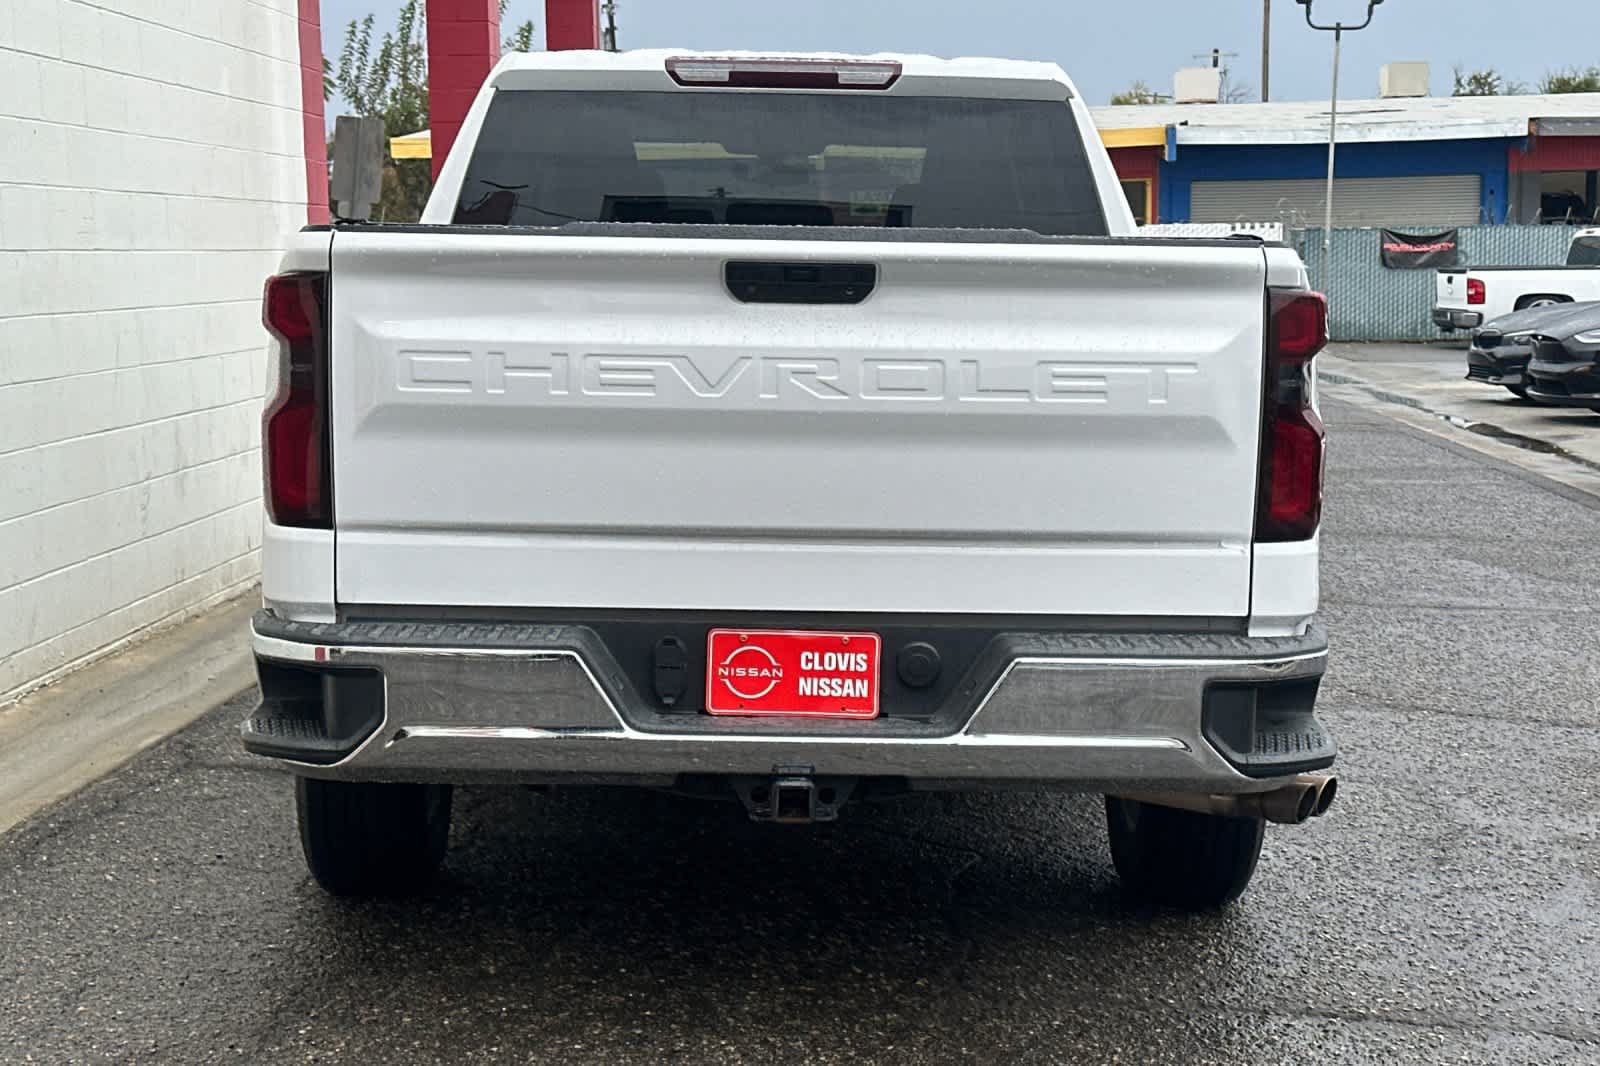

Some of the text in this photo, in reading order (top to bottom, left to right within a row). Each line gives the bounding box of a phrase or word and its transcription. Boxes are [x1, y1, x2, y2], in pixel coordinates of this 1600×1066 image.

[397, 350, 1199, 403] CHEVROLET
[800, 651, 868, 672] CLOVIS
[718, 667, 783, 678] NISSAN
[799, 677, 868, 698] NISSAN
